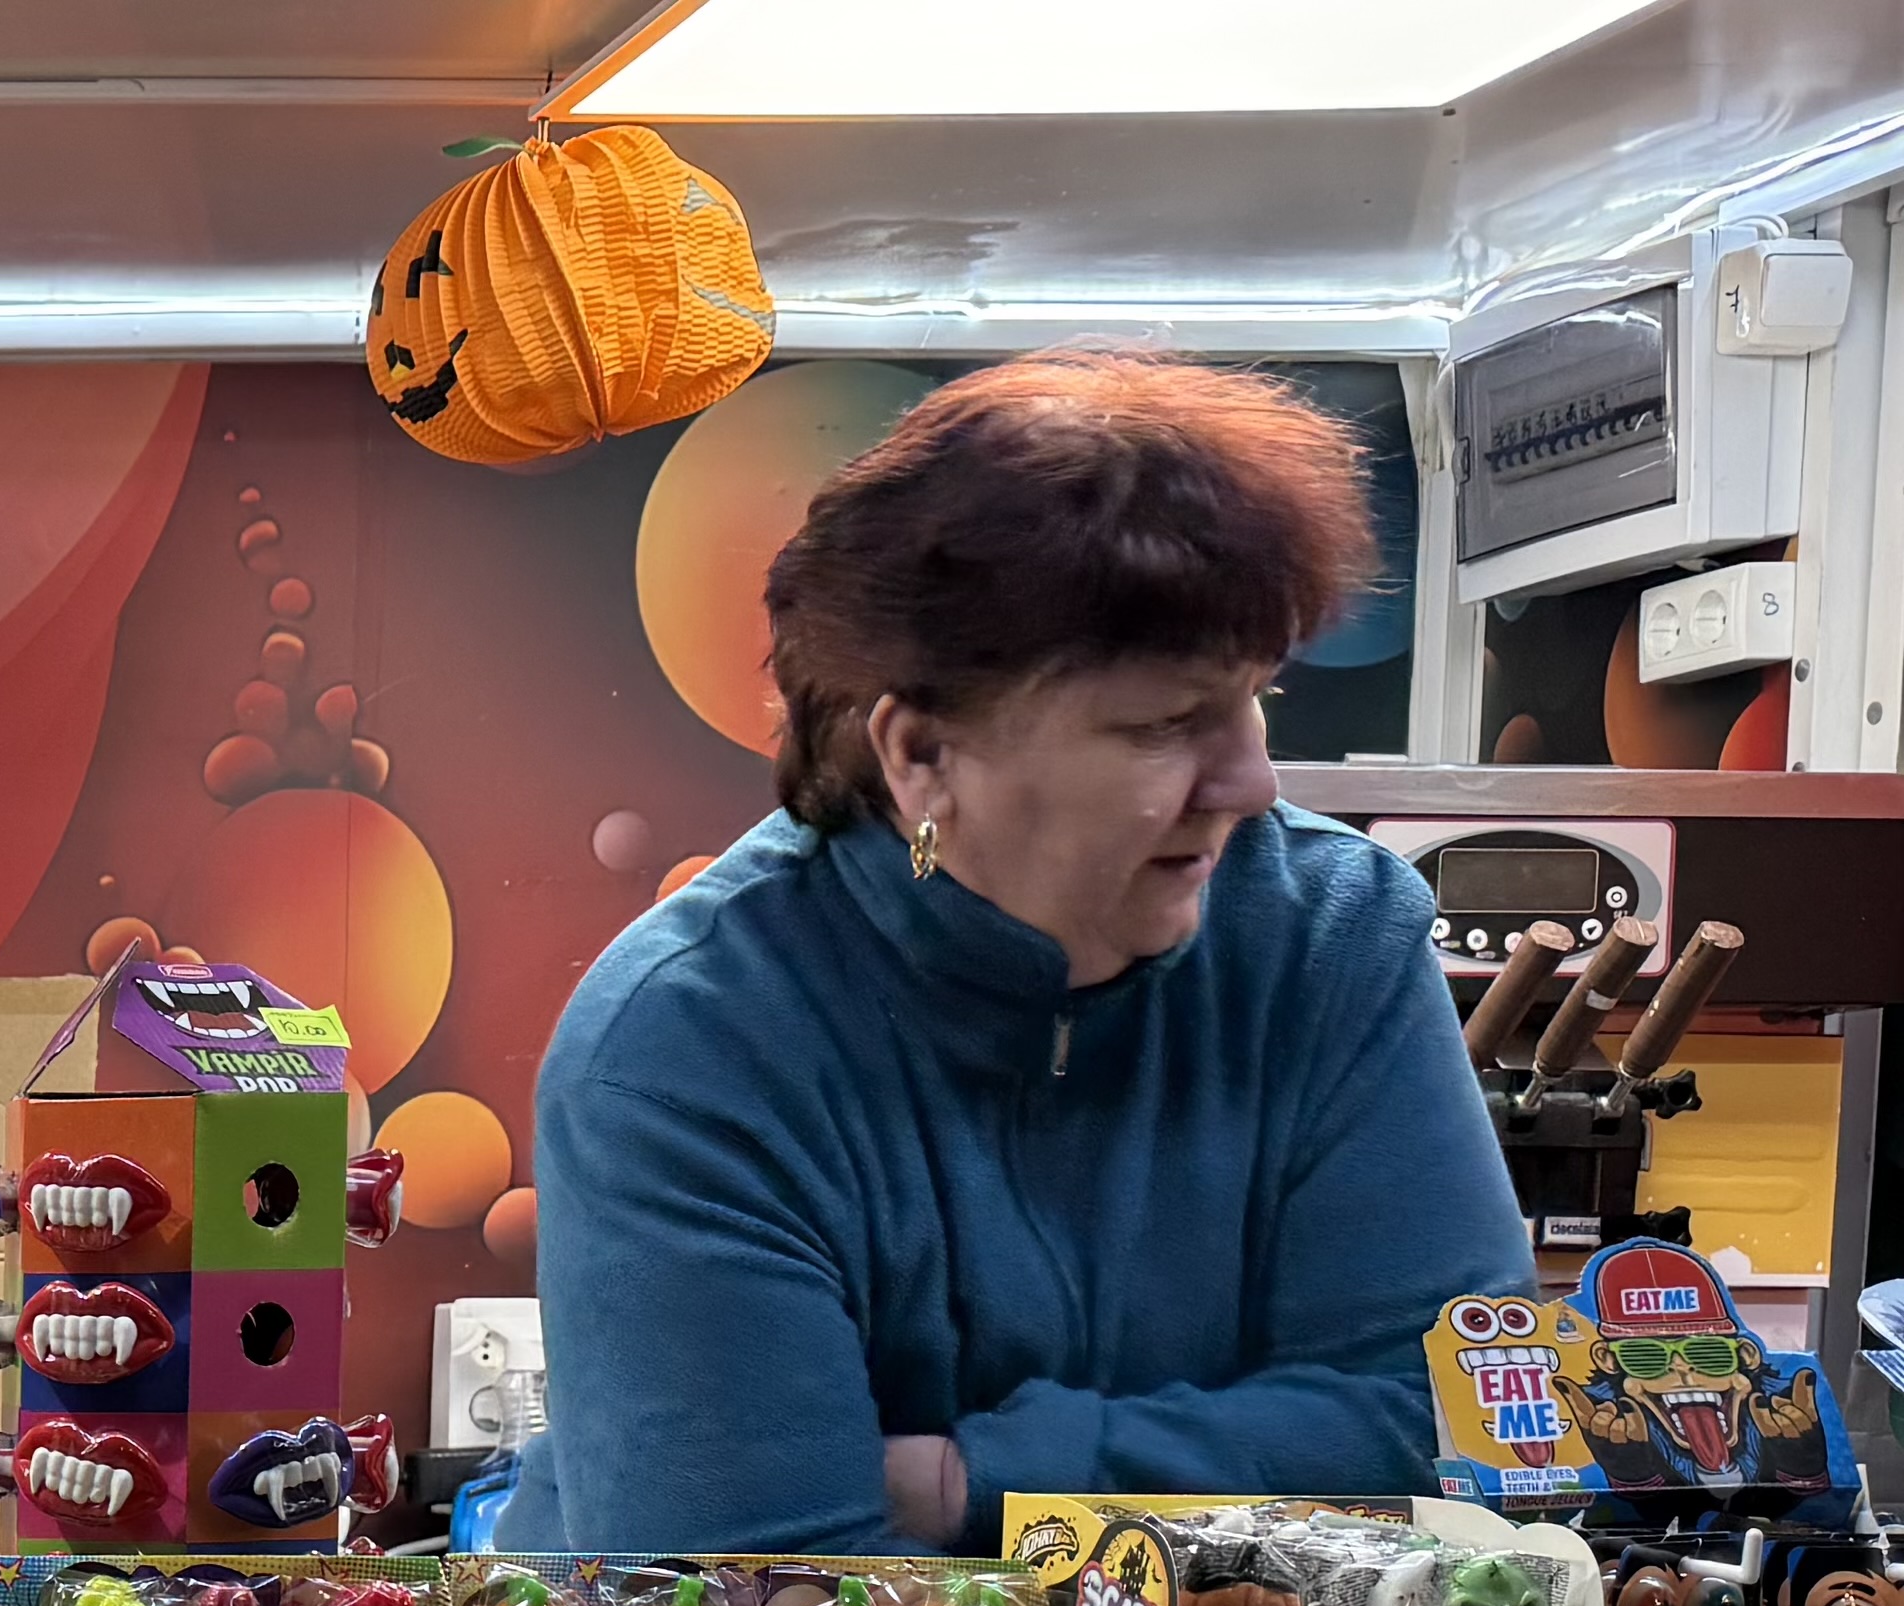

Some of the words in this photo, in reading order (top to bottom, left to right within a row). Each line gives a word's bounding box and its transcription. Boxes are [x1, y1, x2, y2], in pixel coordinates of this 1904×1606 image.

[1762, 593, 1779, 616] 8
[1479, 1368, 1545, 1404] EAT
[1498, 1403, 1559, 1439] ME
[1504, 1470, 1542, 1482] EDIBLE
